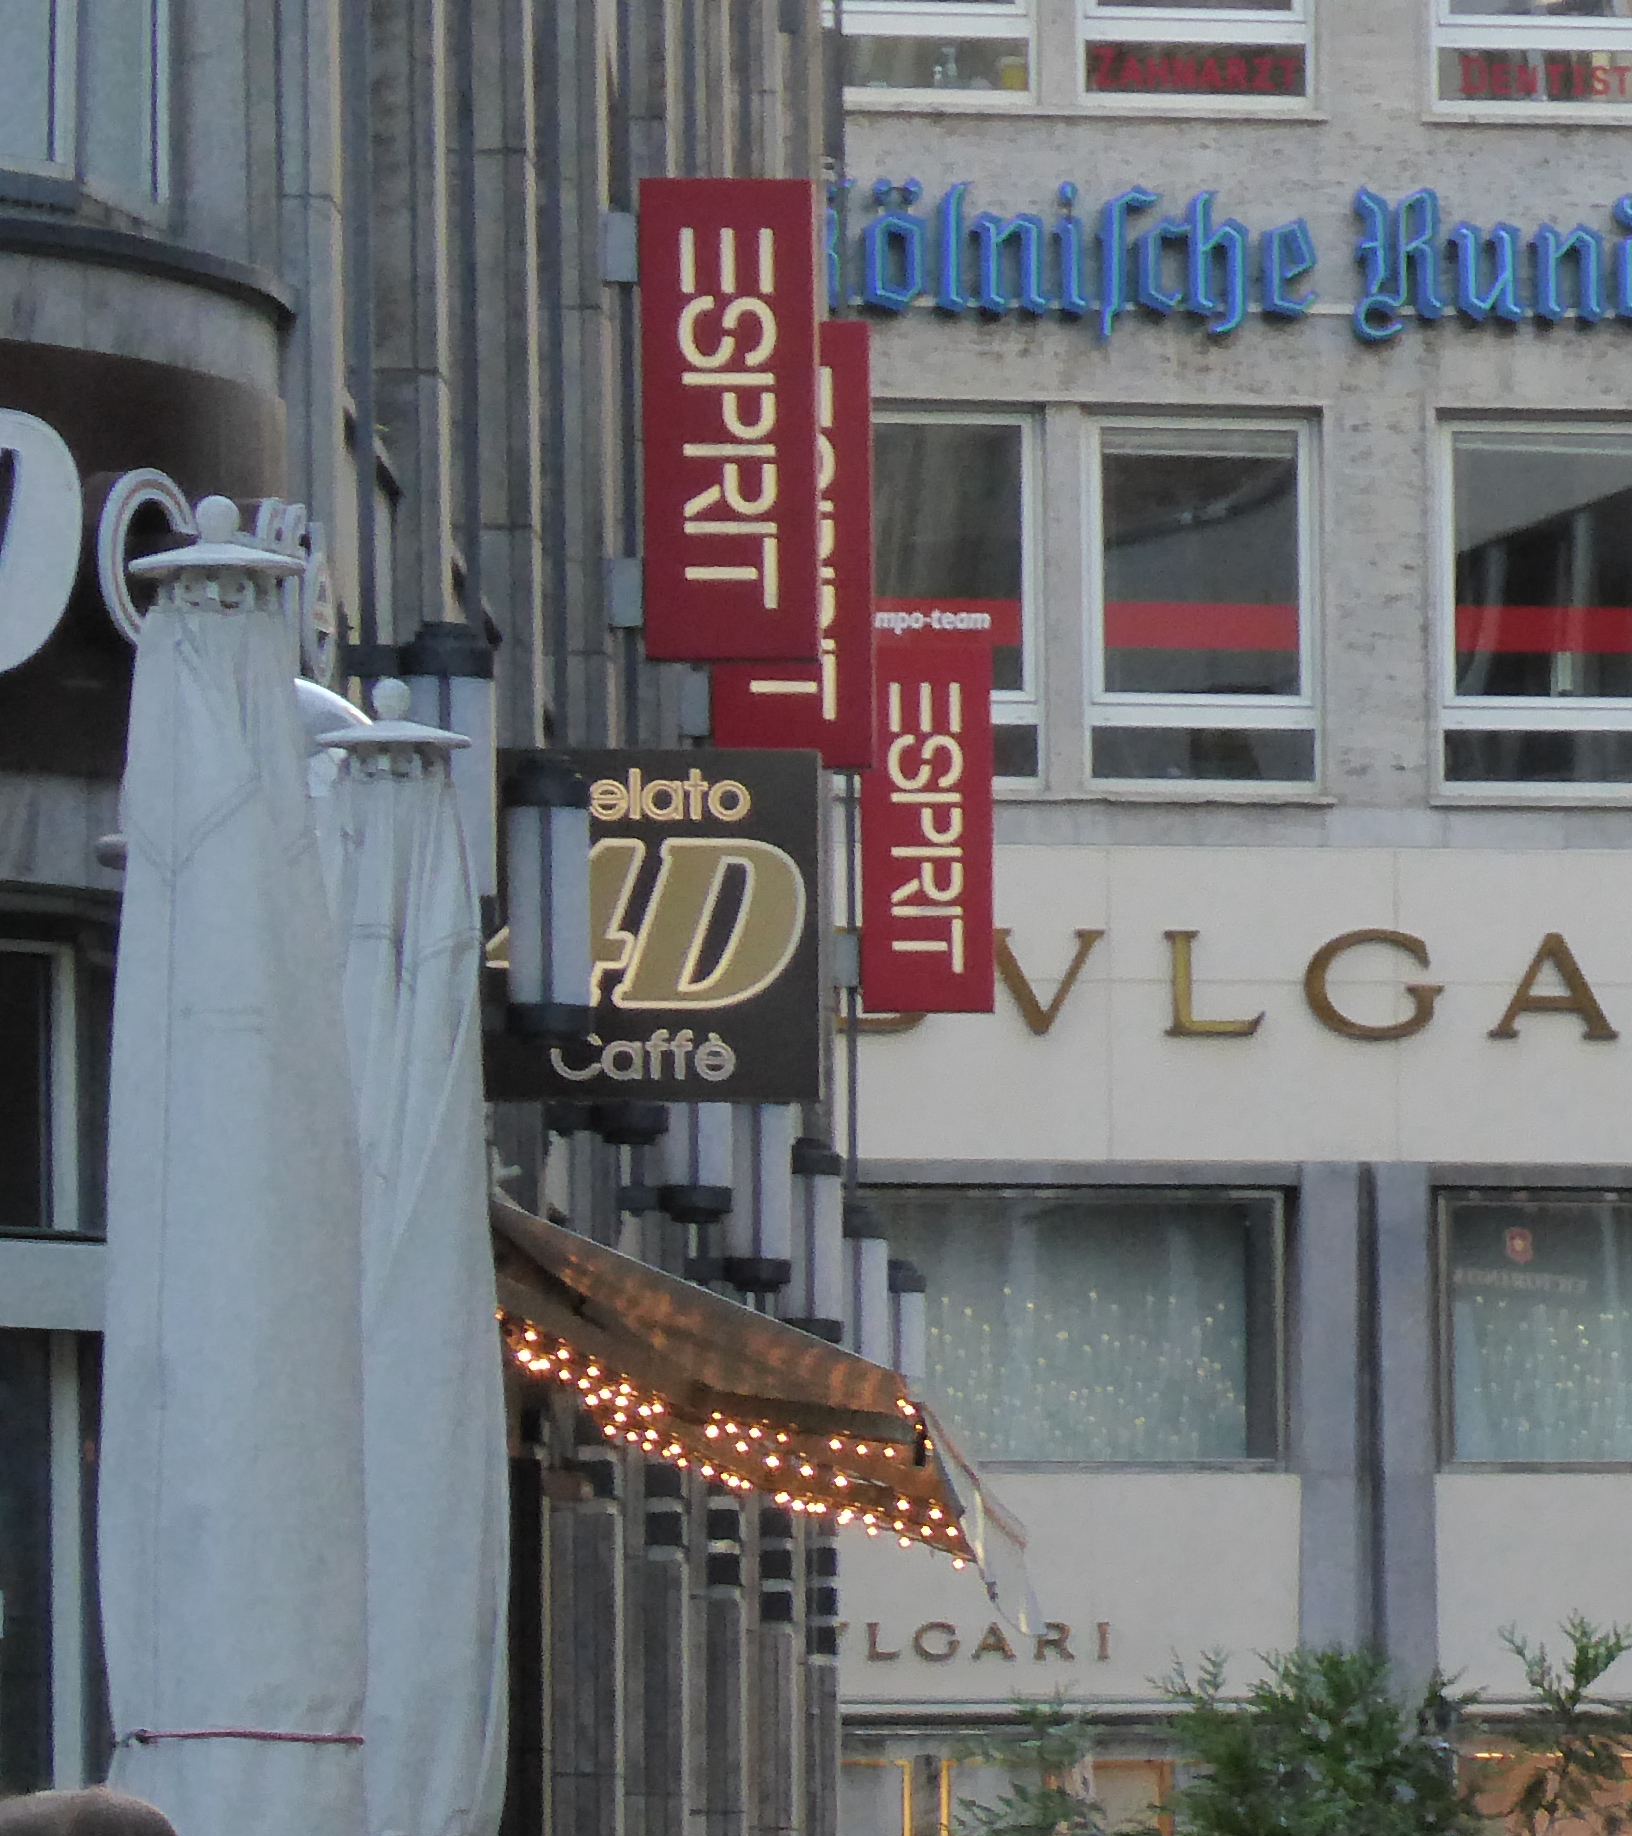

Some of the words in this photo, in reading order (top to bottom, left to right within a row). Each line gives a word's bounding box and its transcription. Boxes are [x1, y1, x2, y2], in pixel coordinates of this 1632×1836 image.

[1092, 45, 1301, 92] ZAHNARZT
[1457, 54, 1632, 98] DENTIST
[677, 227, 779, 610] ESPRIT
[874, 608, 992, 637] mpo-team
[588, 766, 752, 822] elato
[887, 680, 965, 976] ESPRIT
[836, 1620, 1112, 1663] LGARI
